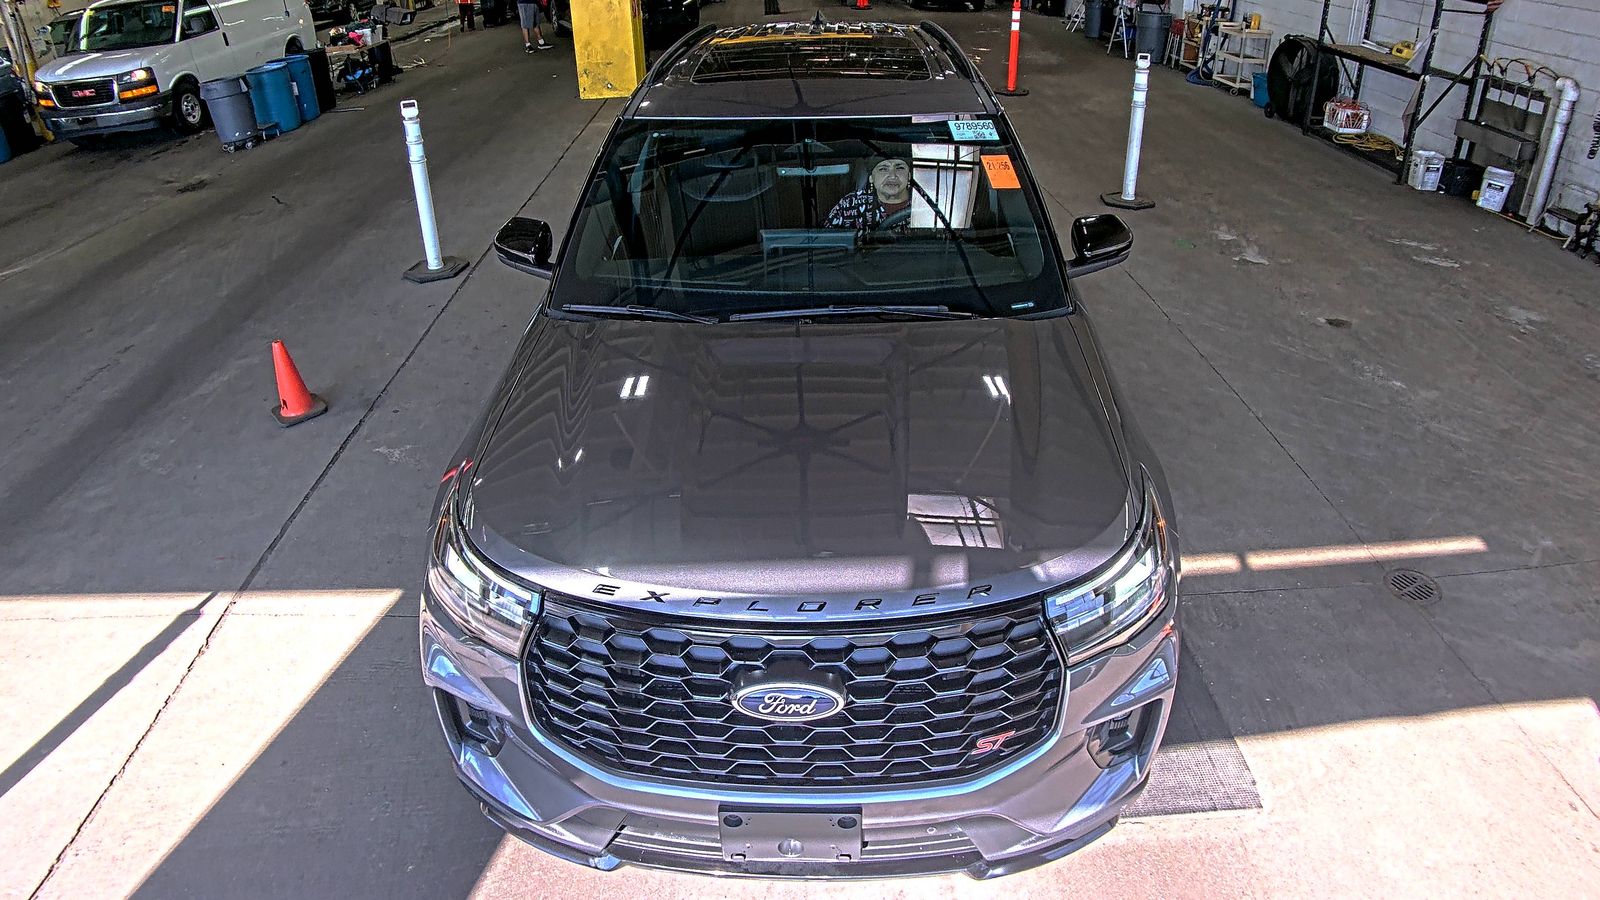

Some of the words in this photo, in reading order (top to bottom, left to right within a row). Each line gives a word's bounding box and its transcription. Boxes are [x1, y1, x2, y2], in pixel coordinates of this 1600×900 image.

[72, 88, 96, 98] GMC
[954, 121, 995, 131] 9789560
[592, 583, 993, 613] EXPLORER
[758, 692, 818, 715] Ford
[970, 730, 1016, 755] ST
